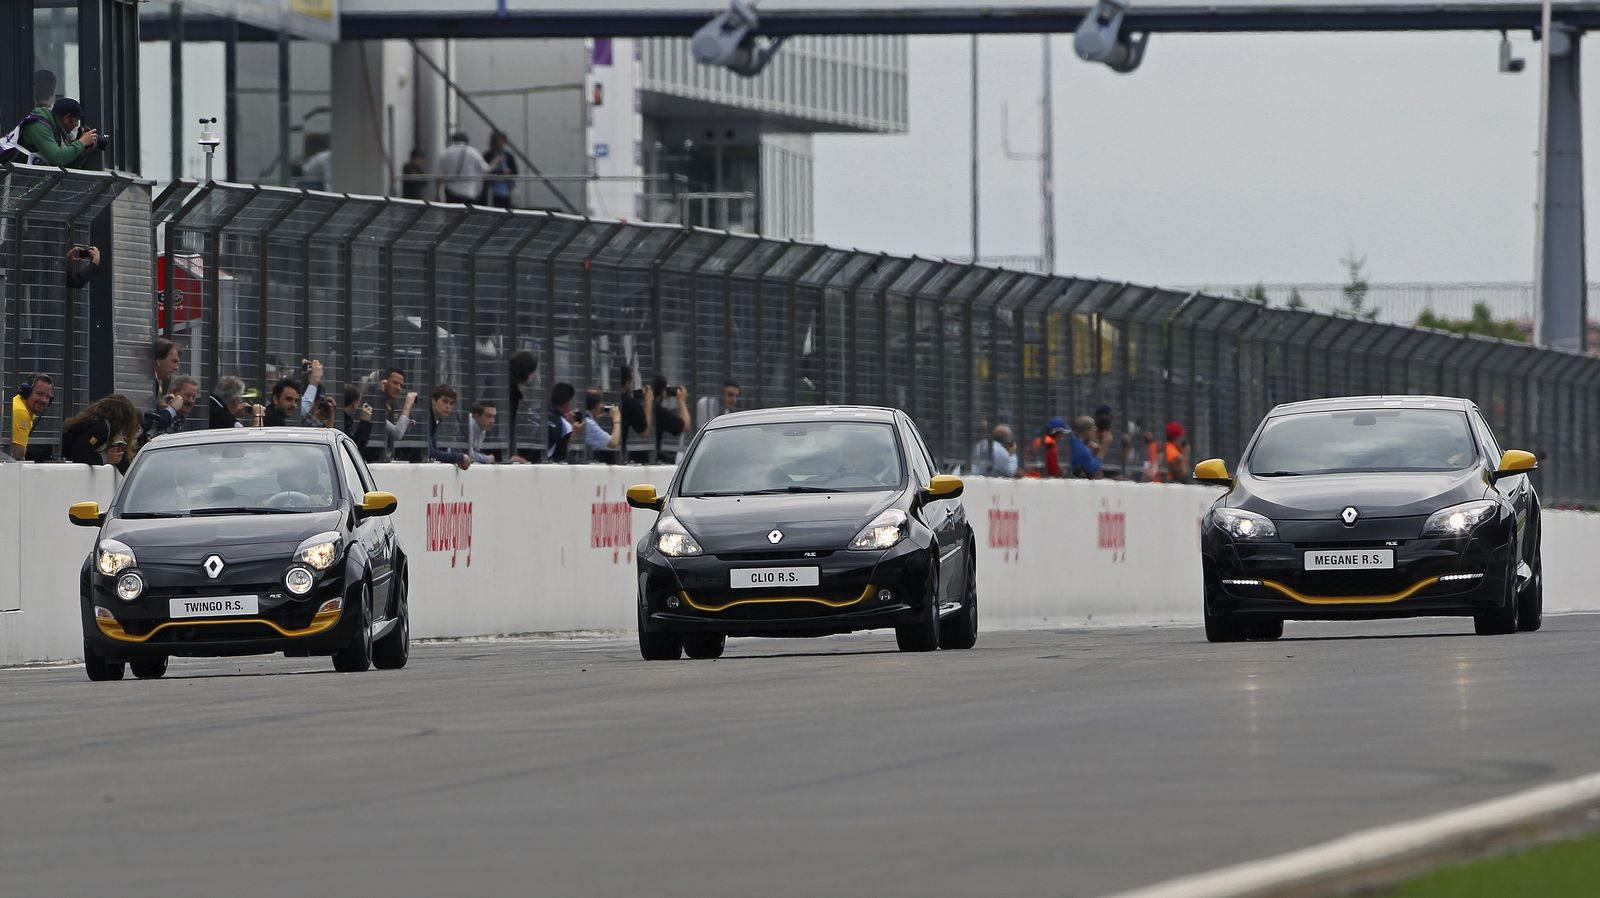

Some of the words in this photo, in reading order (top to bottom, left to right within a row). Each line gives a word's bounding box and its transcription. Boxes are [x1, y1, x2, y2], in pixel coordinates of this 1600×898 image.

[1314, 554, 1359, 565] MEGANE
[1362, 554, 1383, 564] R.S.
[750, 572, 775, 583] CLIO
[778, 572, 799, 582] R.S.
[184, 601, 223, 613] TWINGO
[225, 600, 244, 611] R.S.
